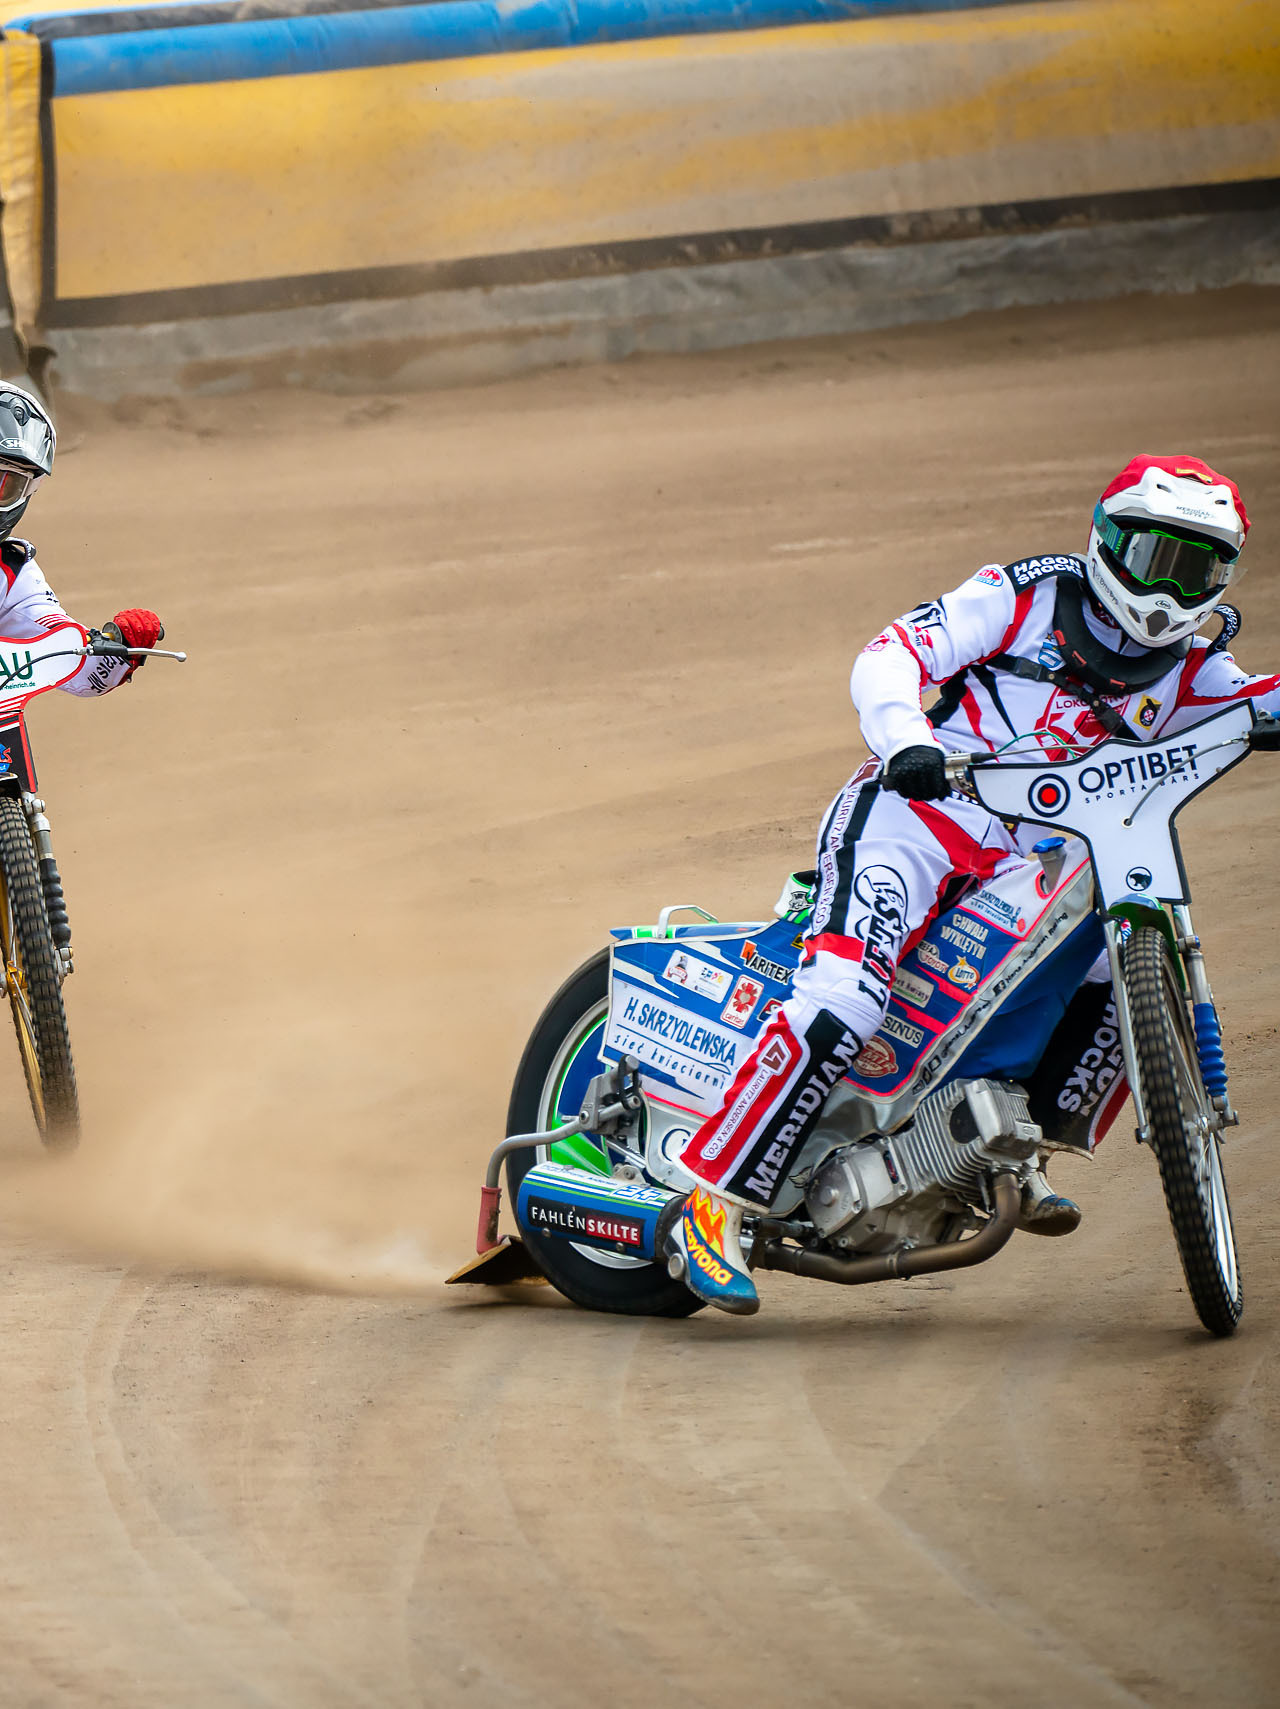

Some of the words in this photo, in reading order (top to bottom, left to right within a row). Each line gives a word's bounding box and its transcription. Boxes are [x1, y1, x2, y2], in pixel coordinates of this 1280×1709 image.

[1013, 557, 1081, 578] HAGON
[1017, 563, 1084, 585] SHOCKS
[1078, 744, 1198, 793] OPTIBET
[1084, 784, 1148, 804] SPORTA
[952, 913, 989, 943] CHWAŁA
[745, 951, 795, 985] VARITEX
[954, 966, 975, 981] LOTTO
[623, 996, 637, 1022] H.
[637, 1002, 738, 1067] SKRZYDLEWSKA
[882, 1016, 922, 1046] SINUS
[1057, 1003, 1121, 1113] HOCKS
[745, 1068, 769, 1101] LAURITZ
[721, 1098, 748, 1138] ANDERSEN
[743, 1030, 861, 1201] MERIDIAN
[683, 1216, 734, 1287] daytona
